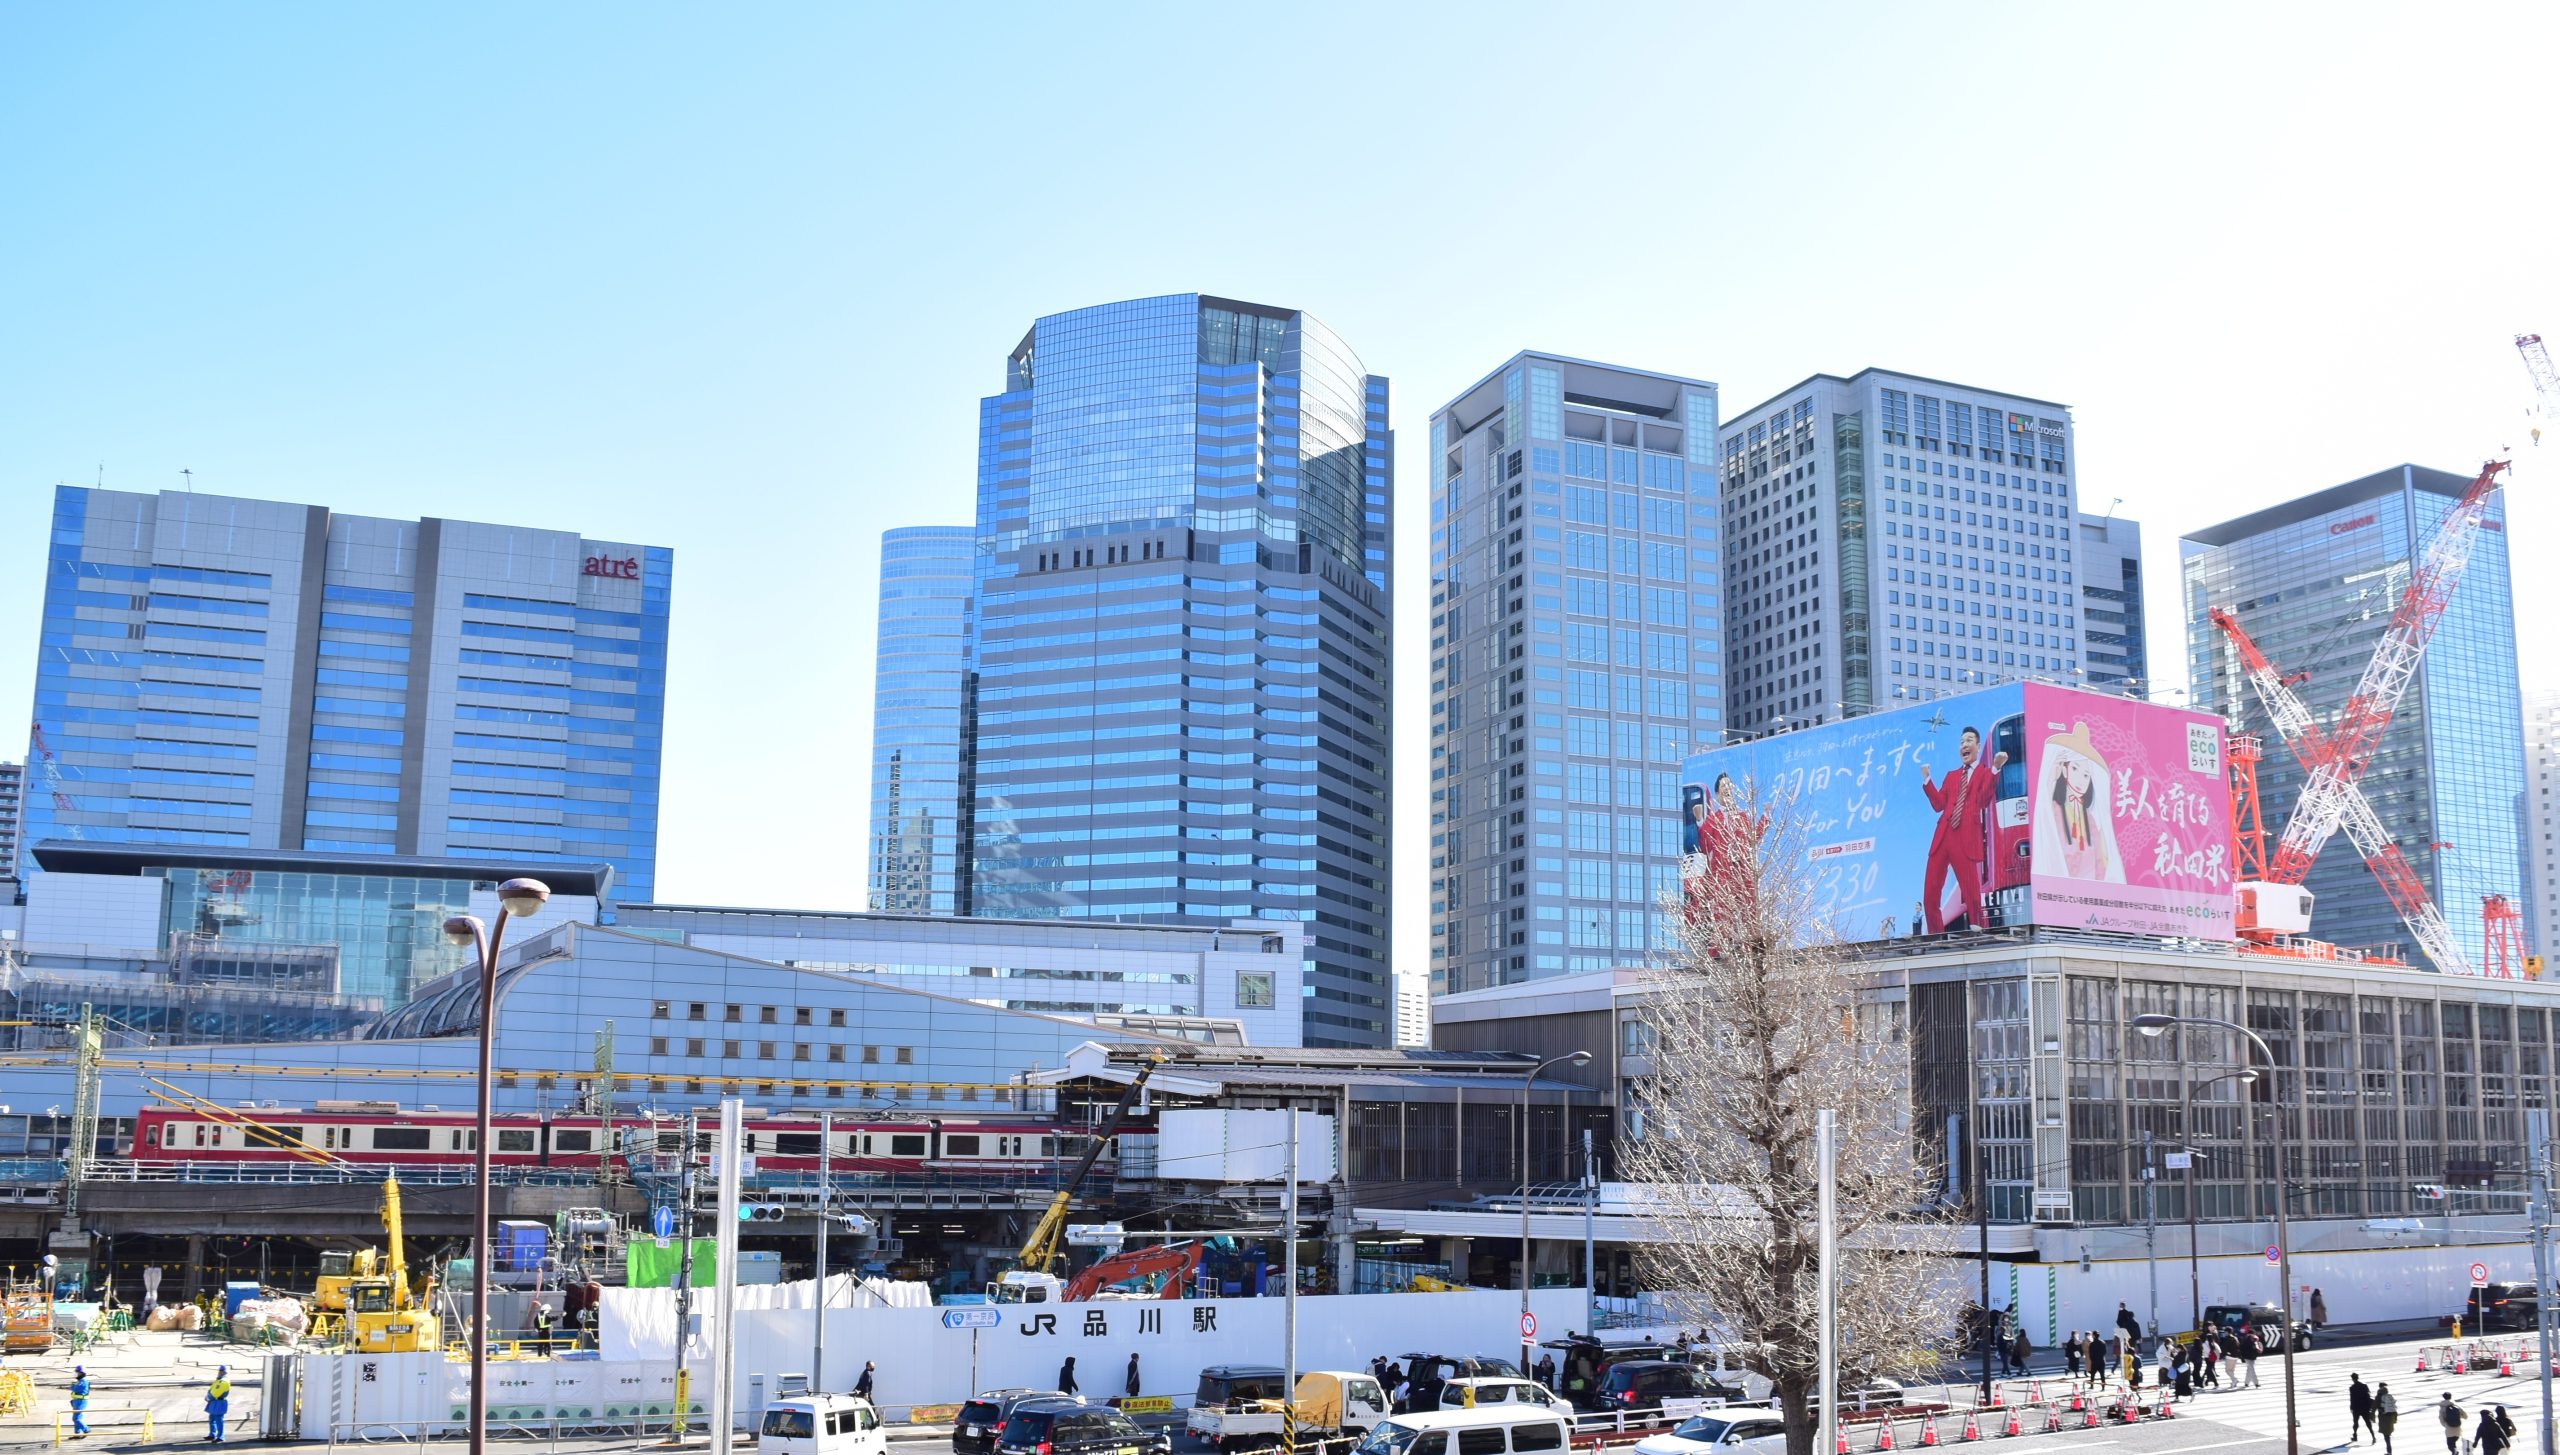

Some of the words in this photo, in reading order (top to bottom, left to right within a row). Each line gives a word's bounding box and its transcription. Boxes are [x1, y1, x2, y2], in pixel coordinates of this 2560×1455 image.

[2024, 421, 2066, 438] Microsoft
[2330, 514, 2374, 535] Canon
[583, 554, 639, 579] atré
[2190, 739, 2216, 755] eco
[1769, 740, 1935, 806] 羽田へまっすぐ
[2191, 754, 2216, 769] らいす
[2116, 768, 2209, 828] 美人を育てる
[1846, 793, 1886, 830] You
[2154, 832, 2229, 887] 秋田米
[1980, 888, 2025, 907] KEIKYU
[1021, 1313, 1057, 1336] JR
